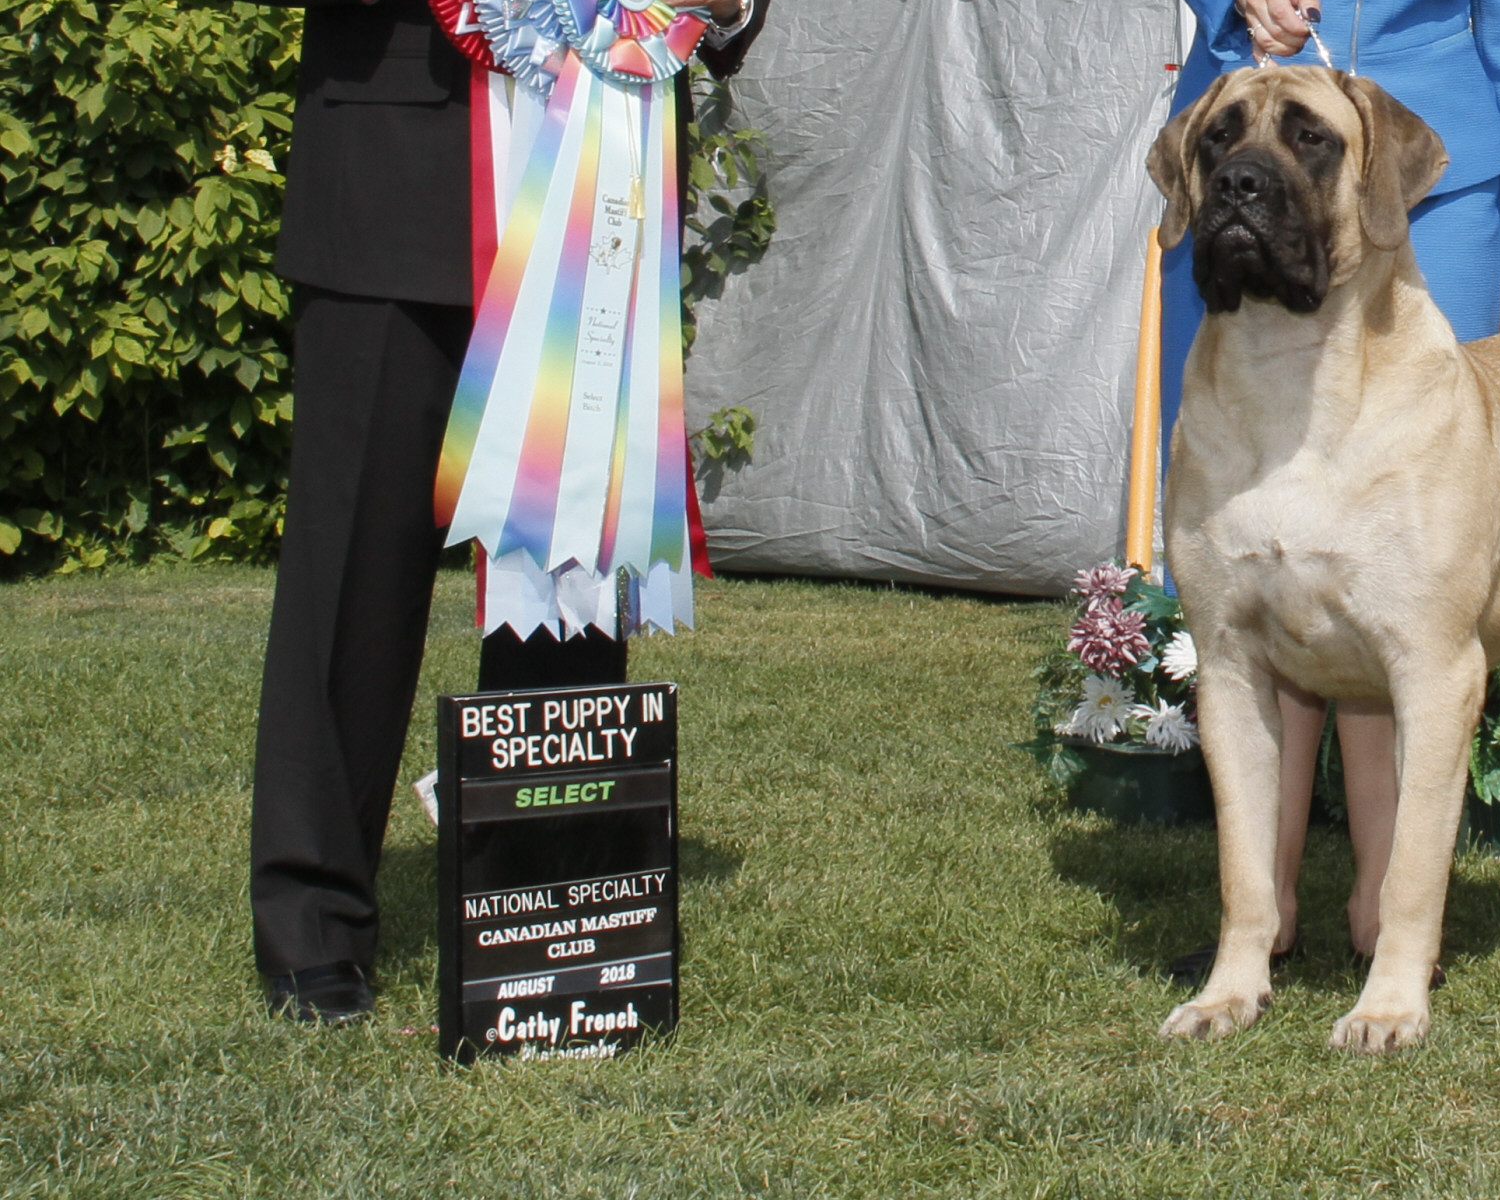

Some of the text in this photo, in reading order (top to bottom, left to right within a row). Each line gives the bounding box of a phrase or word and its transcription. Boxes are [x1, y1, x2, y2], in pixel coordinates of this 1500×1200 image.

[461, 692, 664, 738] BEST PUPPY IN
[492, 727, 638, 770] SPECIALTY
[515, 780, 616, 808] SELECT
[464, 873, 666, 919] NATIONAL SPECIALTY
[478, 907, 658, 947] CANADIAN MASTIFF
[547, 938, 596, 959] CLUB
[496, 963, 636, 1000] AUGUST 2018
[498, 1006, 561, 1044] Cathy
[570, 1000, 638, 1035] French
